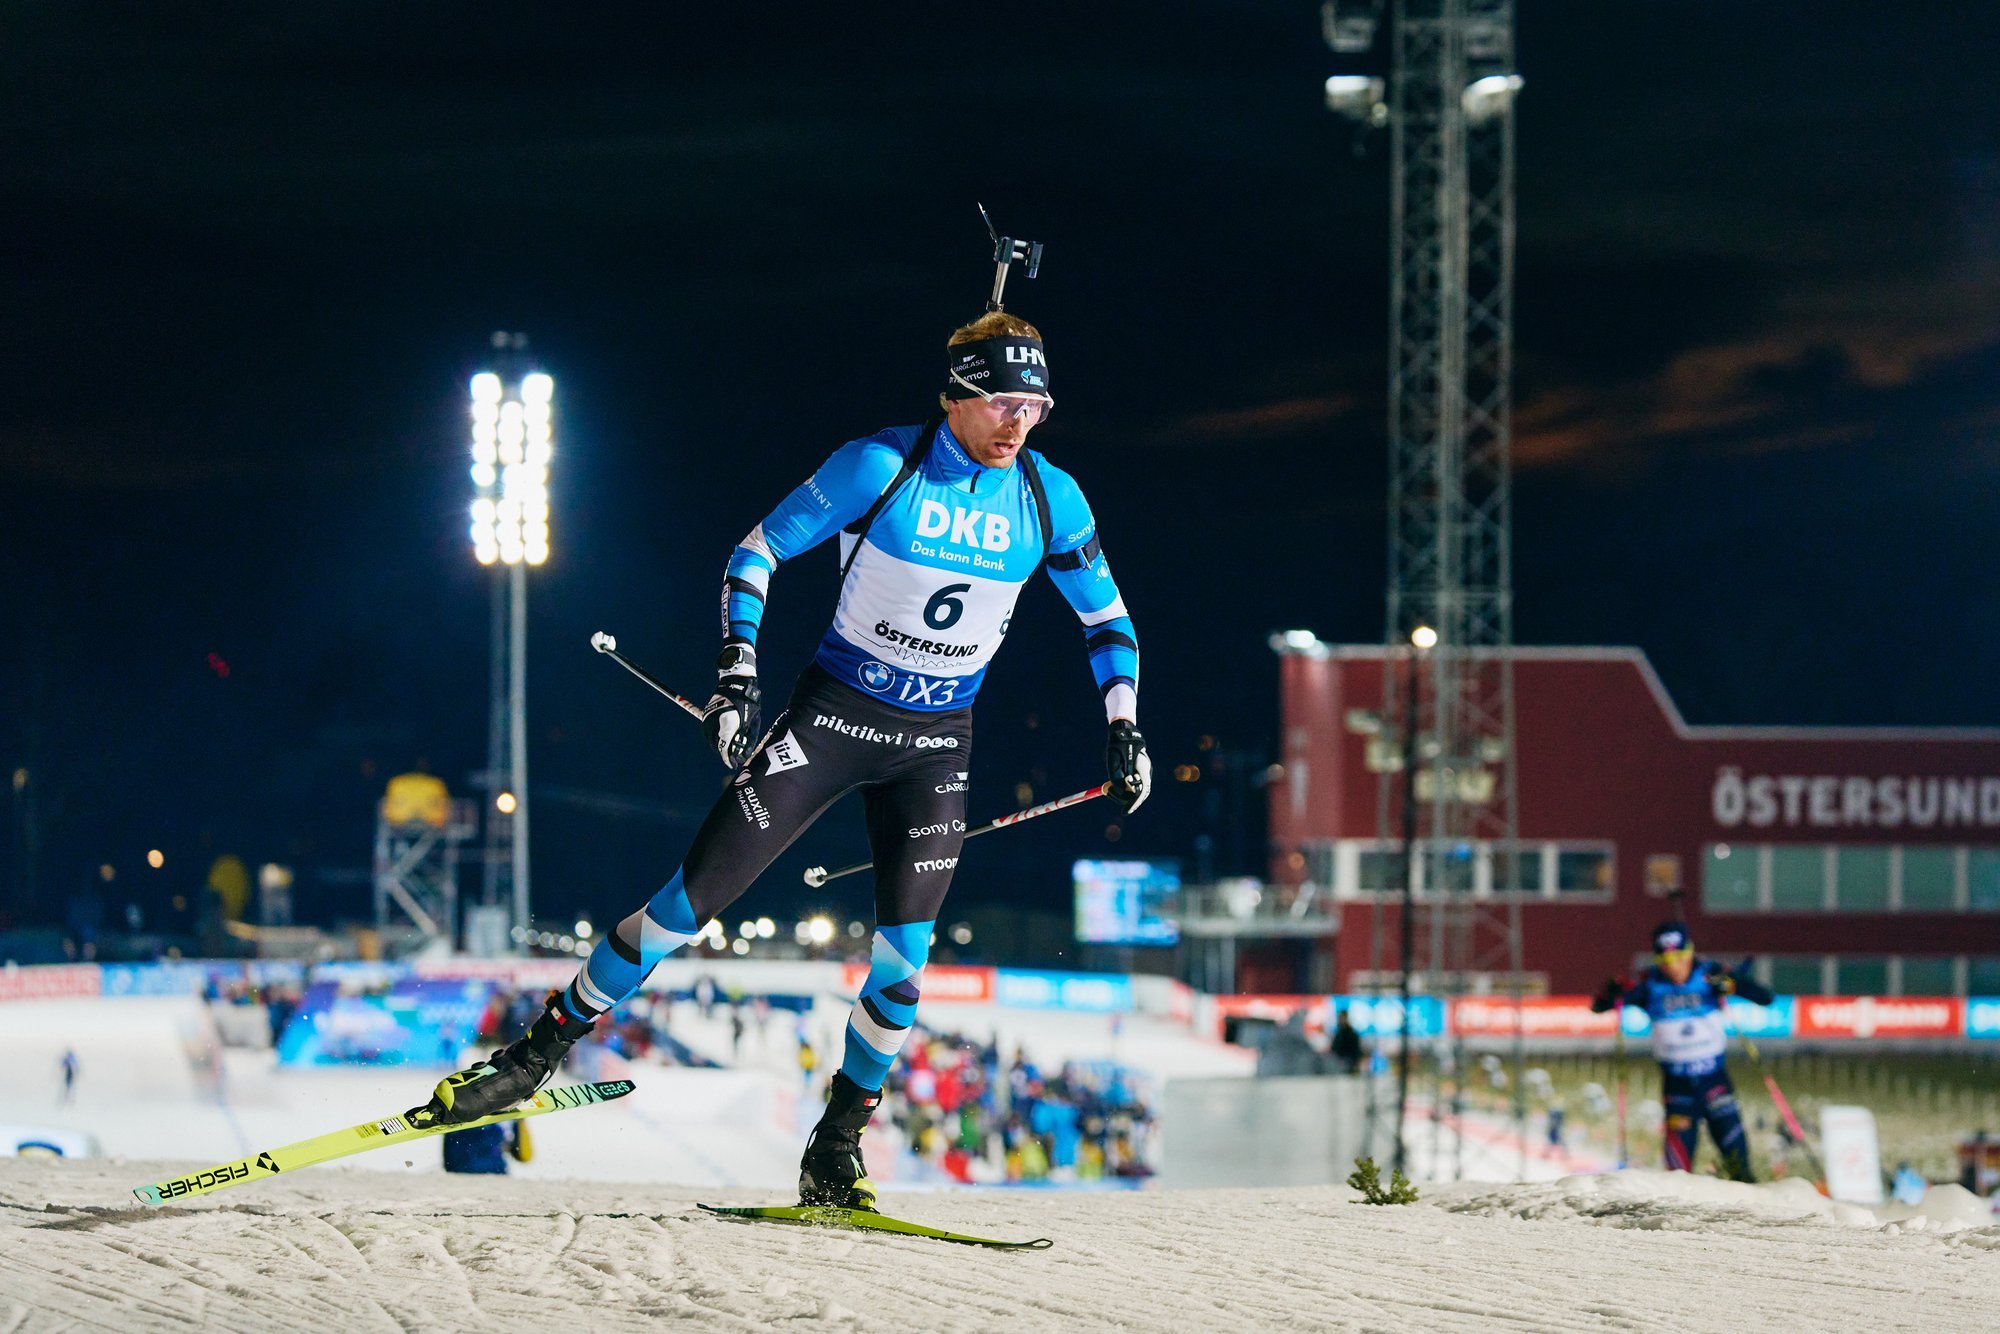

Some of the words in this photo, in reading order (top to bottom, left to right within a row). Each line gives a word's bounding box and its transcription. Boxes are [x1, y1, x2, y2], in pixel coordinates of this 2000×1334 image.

[953, 358, 986, 373] ARGLASS
[915, 498, 1011, 553] DKB
[1067, 524, 1092, 544] Sony
[910, 540, 937, 558] Das
[938, 545, 970, 566] kann
[973, 553, 1005, 572] Bank
[922, 583, 972, 631] 6
[874, 620, 979, 658] ÖSTERSUND
[898, 675, 960, 705] iX3
[812, 714, 904, 745] piletilevi
[773, 742, 798, 767] iizi
[735, 789, 754, 823] PHARMA
[743, 786, 771, 830] auxilia
[908, 822, 949, 839] Sony
[155, 1161, 250, 1200] FISCHER
